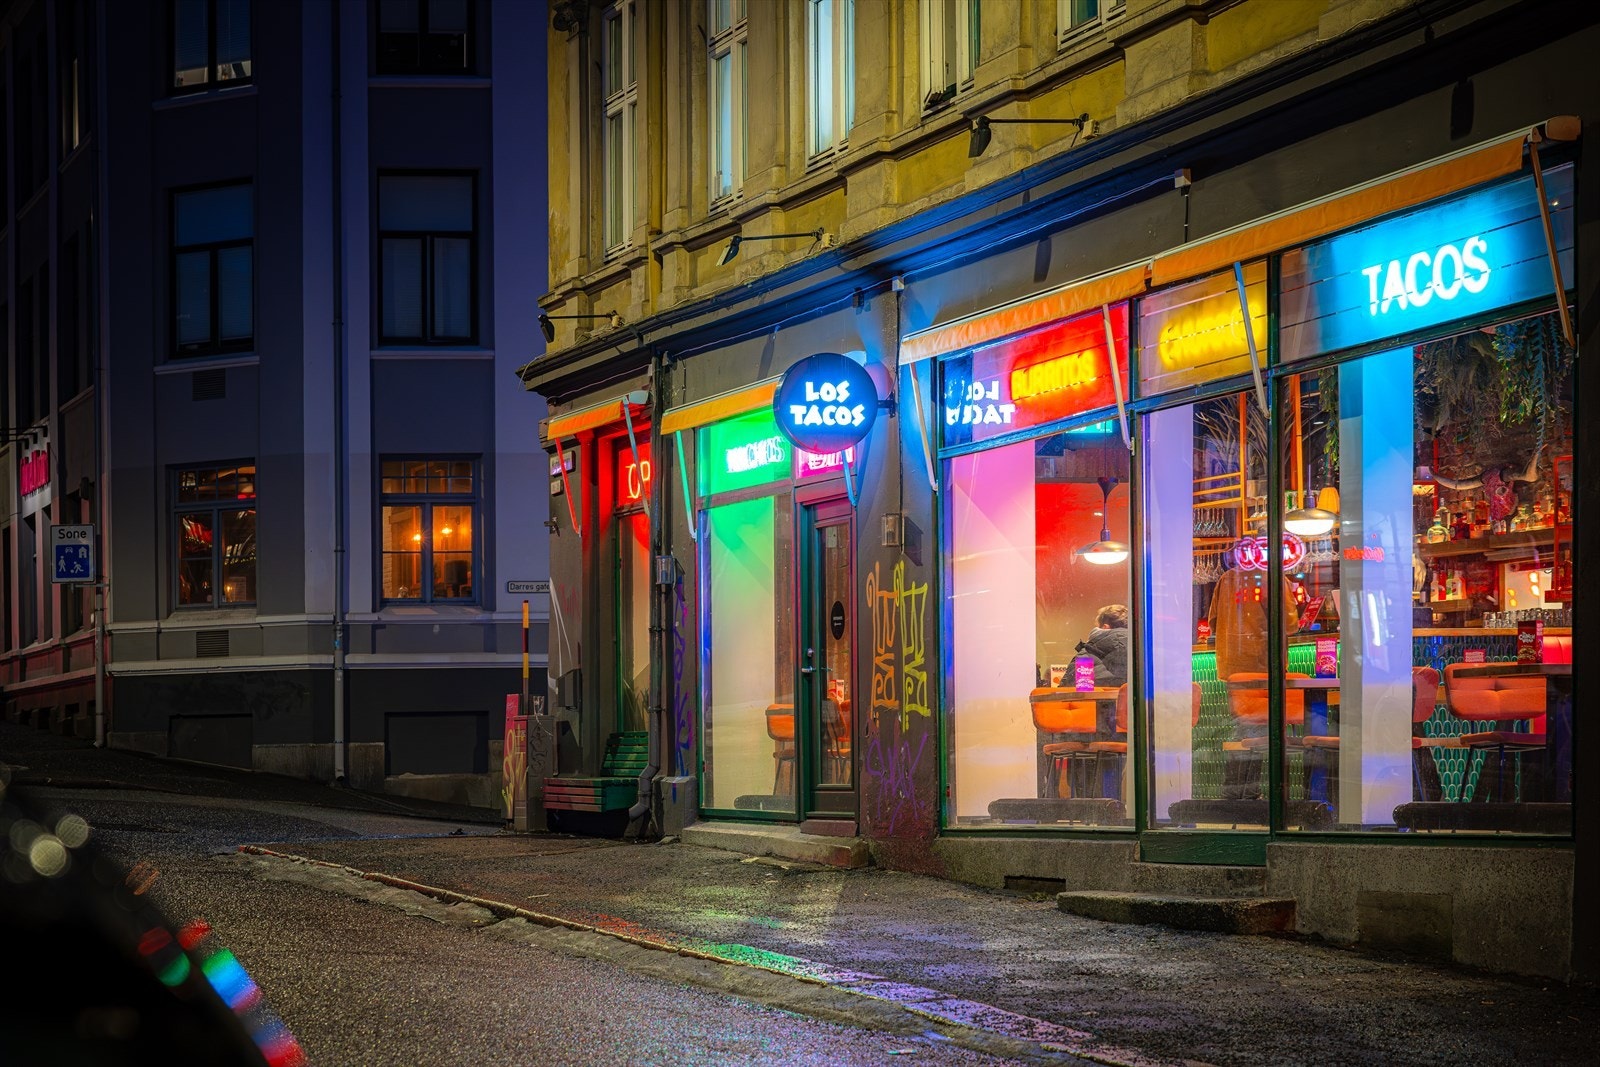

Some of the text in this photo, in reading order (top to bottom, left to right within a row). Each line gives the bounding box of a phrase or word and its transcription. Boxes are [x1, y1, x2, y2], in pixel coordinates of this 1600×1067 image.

[1362, 235, 1491, 316] TACOS
[805, 380, 850, 403] LOS
[789, 404, 865, 427] TACOS
[58, 528, 87, 539] Sone
[510, 582, 534, 591] Darres
